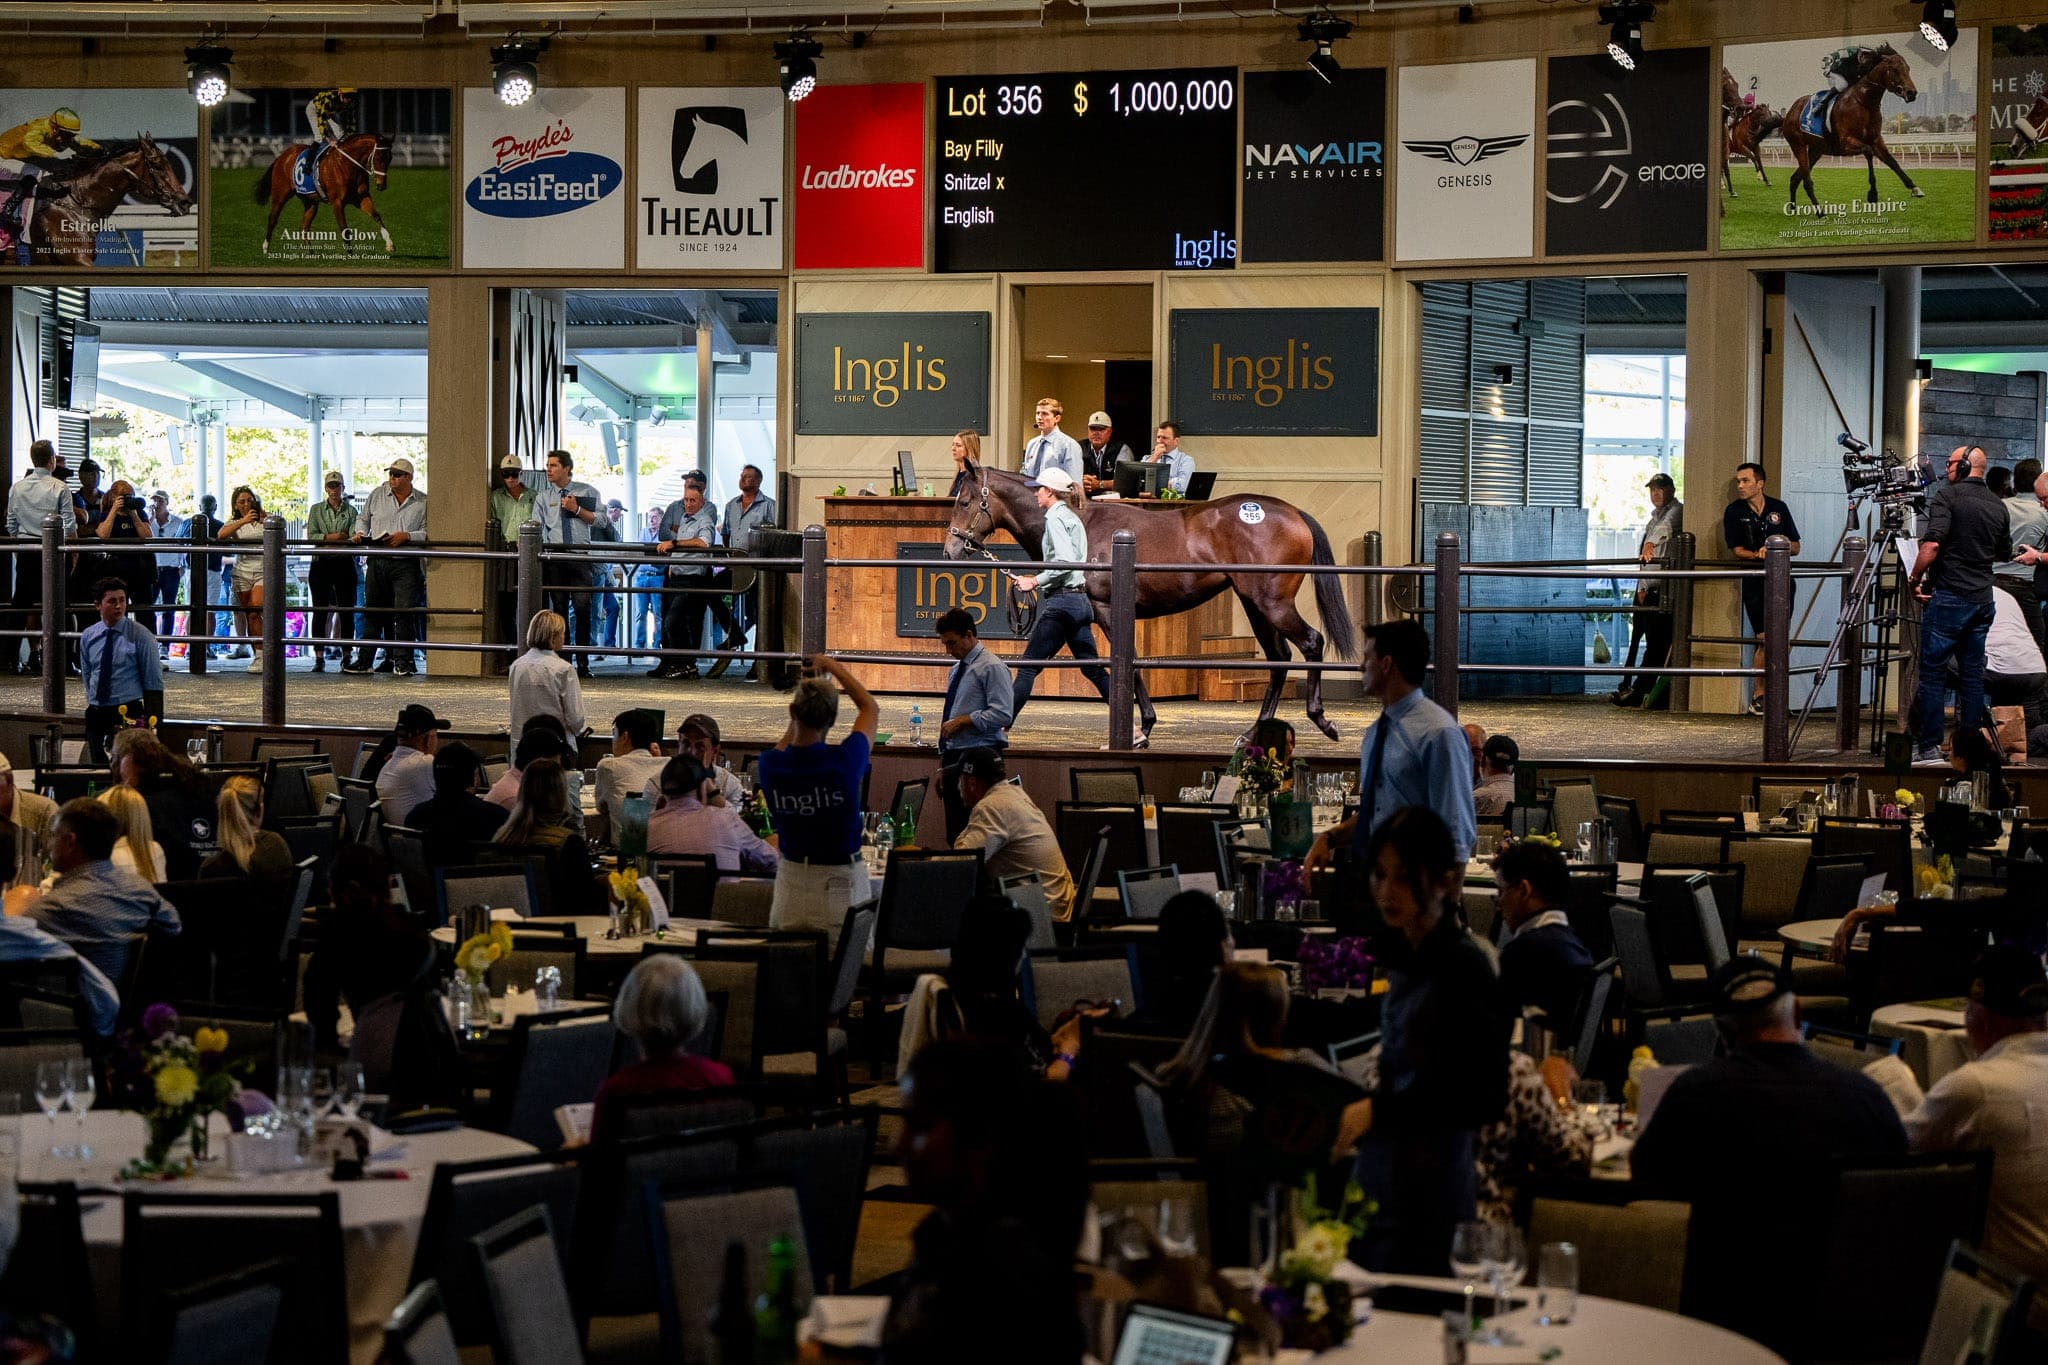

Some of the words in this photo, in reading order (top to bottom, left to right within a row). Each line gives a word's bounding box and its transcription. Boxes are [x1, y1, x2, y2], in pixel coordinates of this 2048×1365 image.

[1750, 76, 1758, 90] 2
[1992, 77, 2017, 93] HE
[949, 87, 986, 116] Lot
[997, 85, 1042, 115] 356
[1073, 81, 1088, 117] $
[1109, 79, 1233, 117] 1,000,000
[492, 119, 574, 166] Pryde's
[945, 140, 972, 161] Bay
[976, 139, 1003, 161] Filly
[1246, 141, 1383, 166] NAVAIR
[802, 163, 916, 189] Ladbrokes
[1246, 170, 1276, 179] JET
[1290, 168, 1383, 179] SERVICES
[1437, 174, 1492, 188] GENESIS
[1638, 163, 1705, 181] encore
[944, 172, 991, 191] Snitzel
[996, 176, 1005, 190] x
[642, 197, 778, 236] THEAULT
[1783, 201, 1847, 217] Growing
[1851, 198, 1907, 216] Empire
[61, 218, 117, 232] Estriella
[944, 206, 994, 228] English
[280, 228, 337, 241] Autumn
[341, 228, 378, 241] Glow
[1795, 230, 1813, 238] Inglis
[53, 247, 71, 256] Inglis
[283, 252, 300, 260] Inglis
[679, 243, 708, 252] SINCE
[714, 243, 738, 252] 1924
[1175, 230, 1237, 268] Inglis
[834, 341, 946, 408] Inglis
[1212, 338, 1335, 407] Inglis
[834, 395, 846, 403] EST
[849, 395, 866, 403] 1867
[1212, 393, 1225, 401] EST
[1228, 393, 1246, 401] 1867
[915, 610, 929, 619] EST
[931, 610, 946, 619] 186
[773, 786, 846, 817] Inglis
